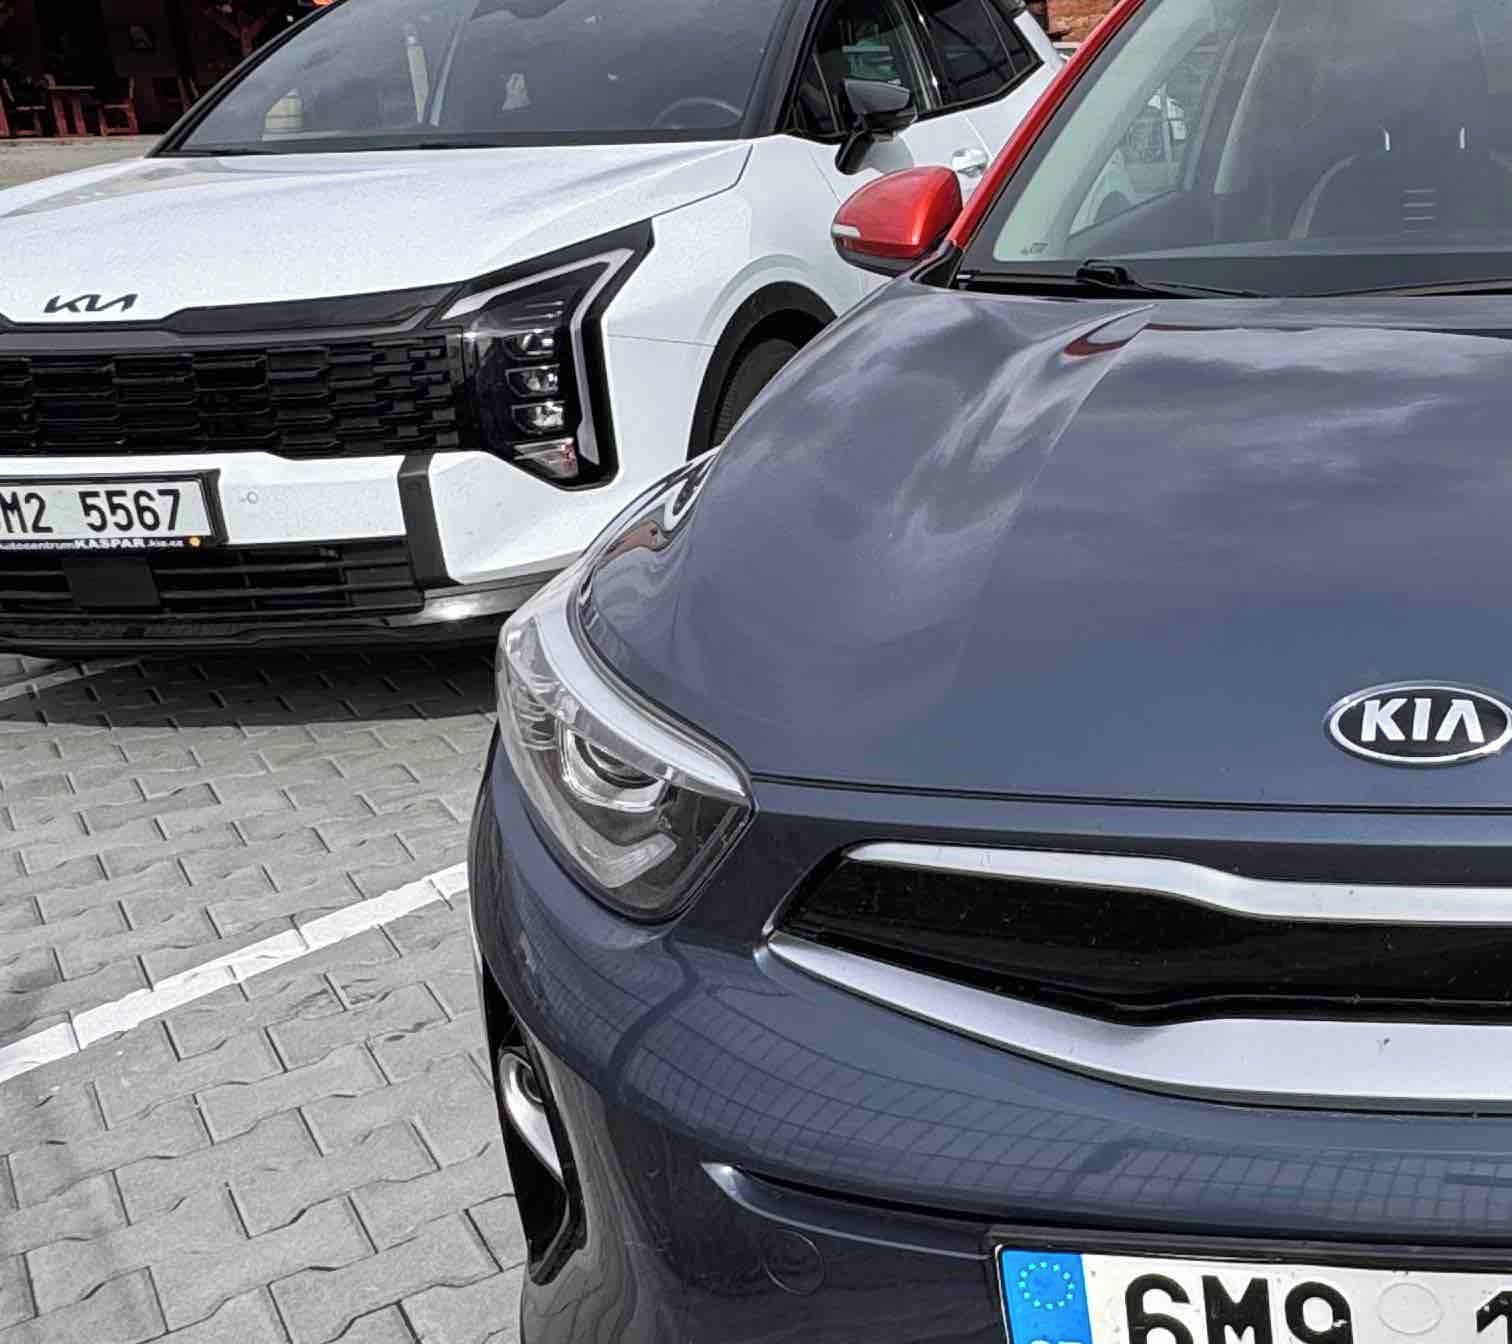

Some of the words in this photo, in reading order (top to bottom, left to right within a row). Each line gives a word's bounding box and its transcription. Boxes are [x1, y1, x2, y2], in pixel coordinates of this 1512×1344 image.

[43, 293, 138, 313] KIA
[78, 489, 181, 532] 5567
[1361, 698, 1485, 743] KIA
